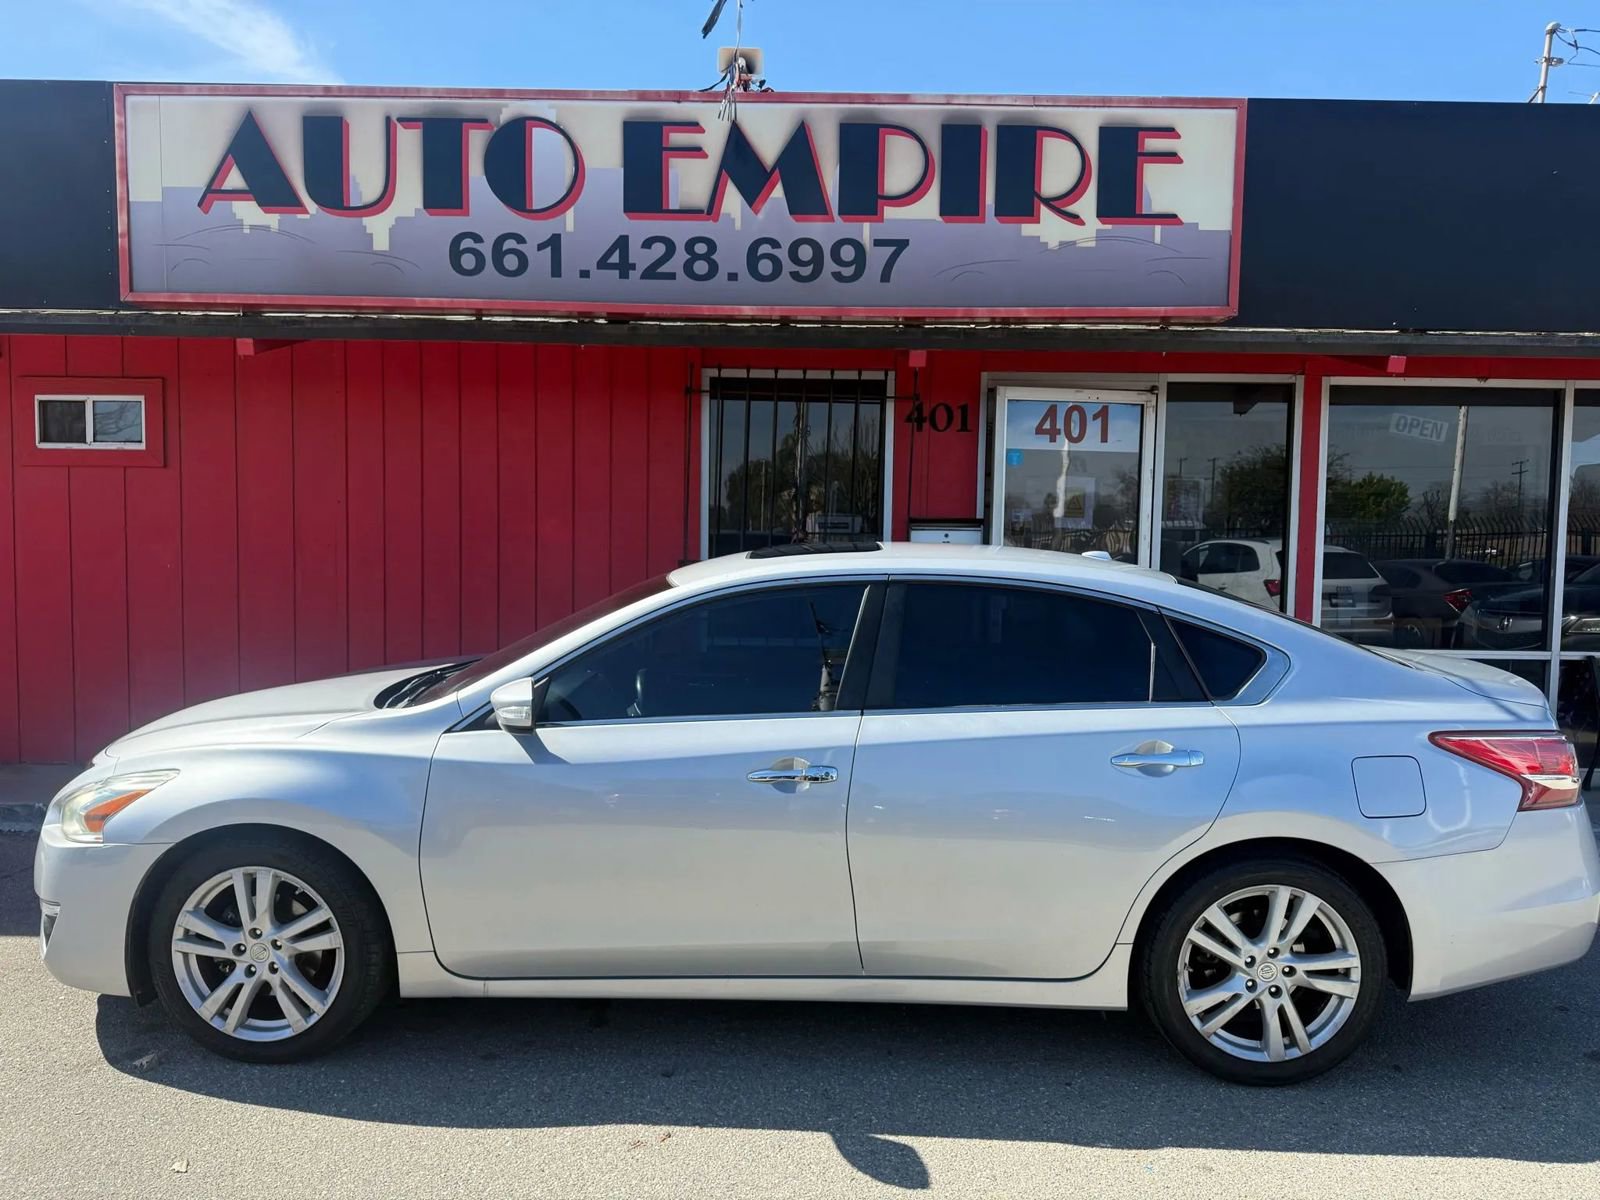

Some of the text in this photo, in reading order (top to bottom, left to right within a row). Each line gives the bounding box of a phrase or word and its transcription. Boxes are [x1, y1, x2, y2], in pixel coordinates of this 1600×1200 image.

[197, 108, 1184, 226] AUTO EMPIRE
[448, 231, 910, 284] 661.428.6997
[904, 402, 973, 433] 401
[1034, 403, 1110, 444] 401
[1395, 415, 1444, 440] OPEN
